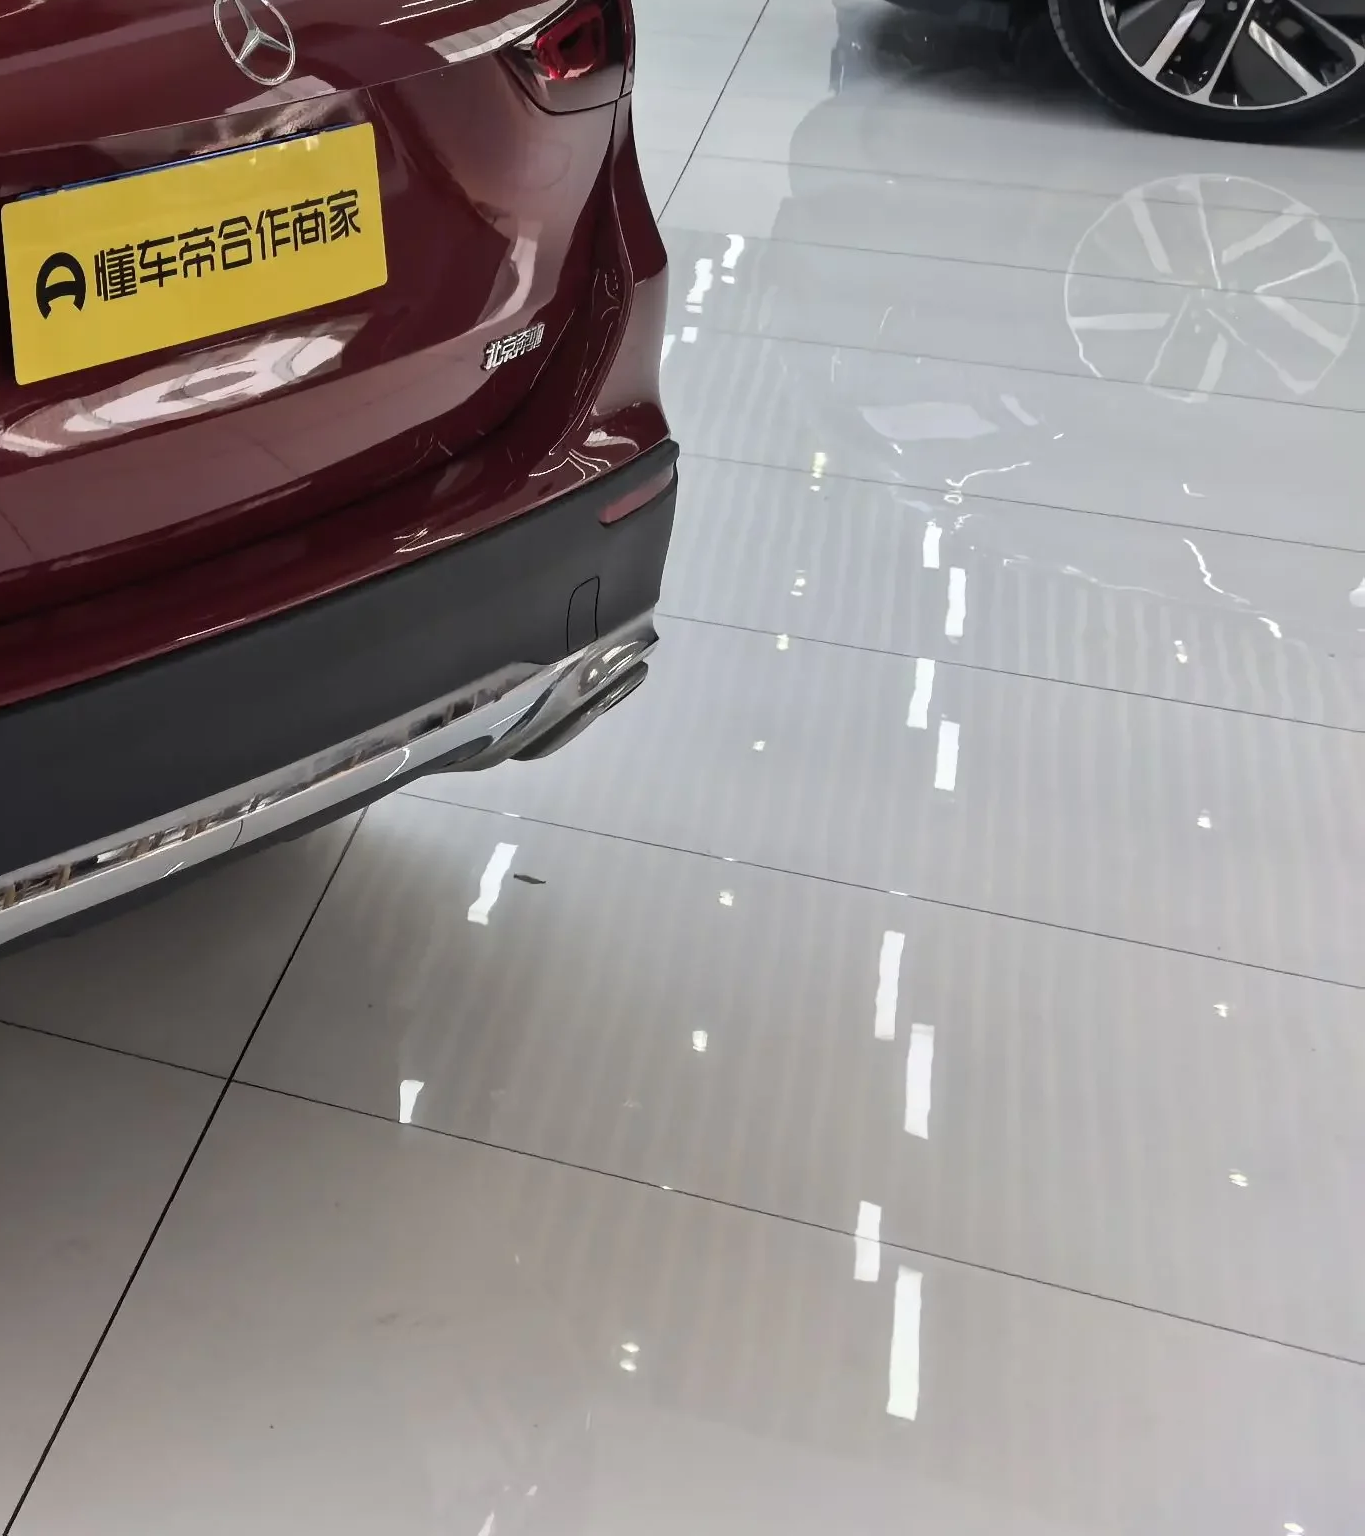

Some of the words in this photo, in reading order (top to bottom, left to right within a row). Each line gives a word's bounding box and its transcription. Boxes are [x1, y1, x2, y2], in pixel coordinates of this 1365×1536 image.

[93, 189, 362, 302] 懂车帝合作商家
